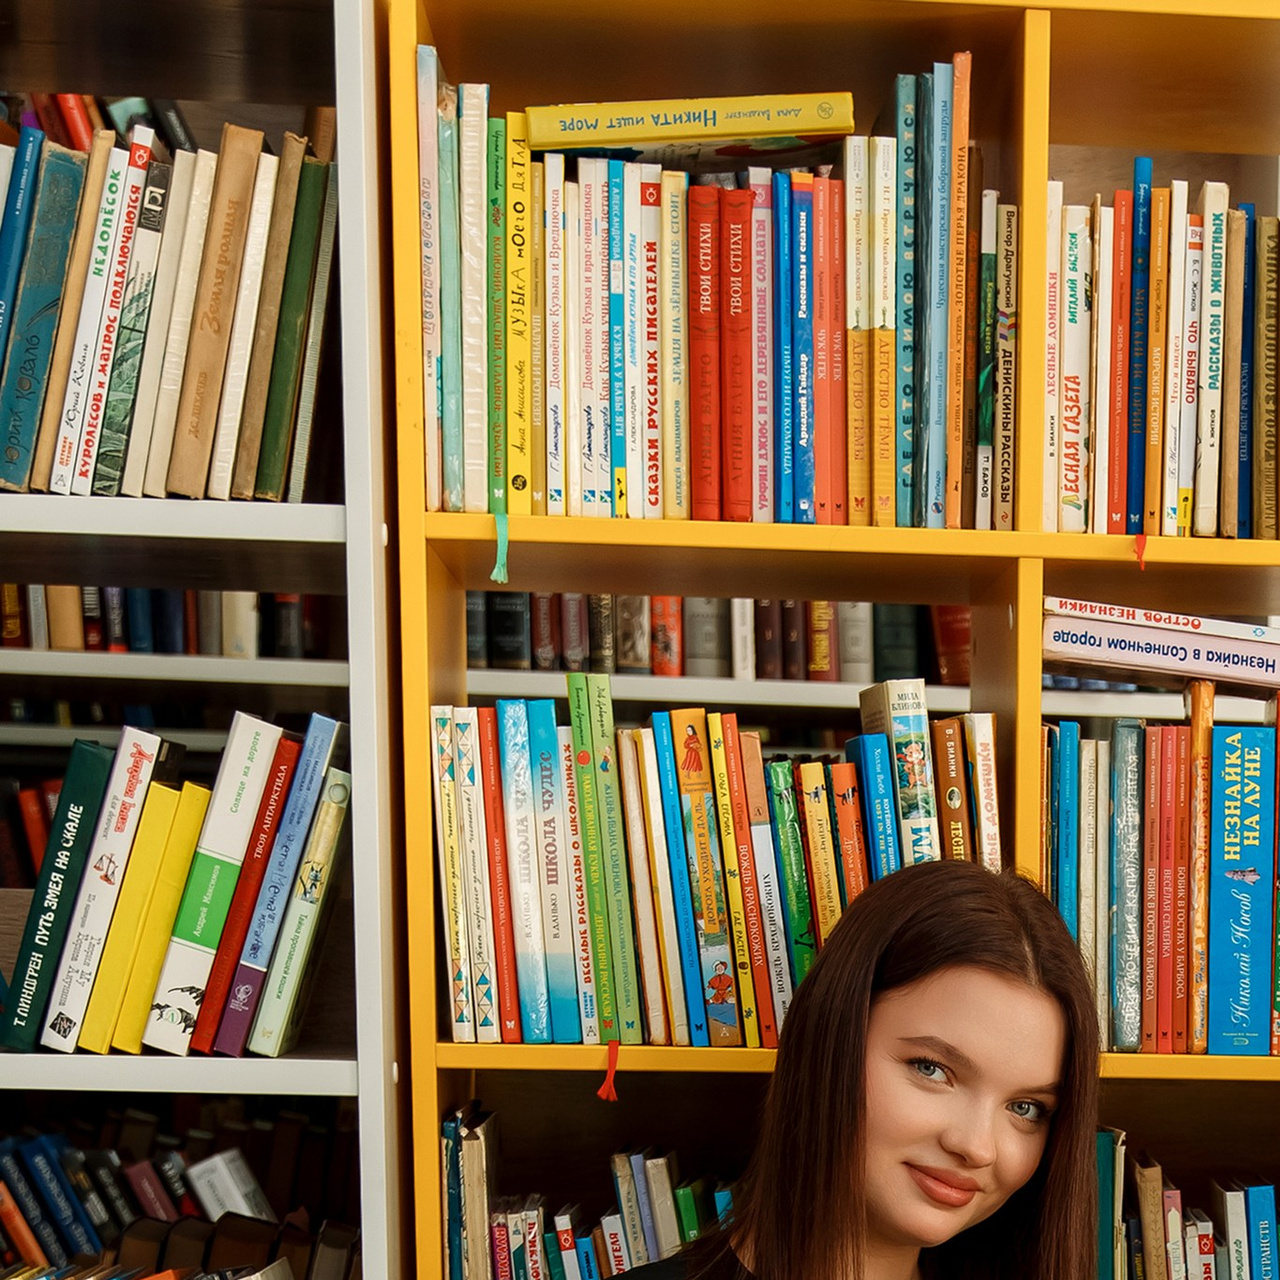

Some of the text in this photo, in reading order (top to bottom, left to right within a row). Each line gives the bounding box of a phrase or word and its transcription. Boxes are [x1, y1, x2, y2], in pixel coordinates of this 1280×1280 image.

[941, 100, 950, 143] запруды
[938, 147, 948, 193] бобровой
[93, 169, 121, 277] НЕДОПЁСОК
[698, 223, 712, 313] ТВОИ СТИХИ
[799, 212, 808, 251] сказки
[938, 205, 949, 261] мастерская
[955, 145, 966, 306] ЗОЛОТЫЕ ПЕРЬЯ ДРАКОНА
[549, 189, 561, 389] Домовёнок Кузька и Вреднючка
[668, 191, 682, 385] ЗЕМЛЯ НА ЗЁРНЫШКЕ СТОИТ
[798, 265, 808, 319] Рассказы
[936, 264, 947, 309] Чудесная
[1208, 212, 1223, 390] РАССКАЗЫ О ЖИВОТНЫХ
[1047, 272, 1057, 397] ЛЕСНЫЕ ДОМИШКИ
[1000, 348, 1011, 503] ДЕНИСКИНЫ РАССКАЗЫ
[1061, 375, 1082, 509] ЛЕСНАЯ ГАЗЕТА
[1052, 628, 1103, 649] городе
[1107, 637, 1189, 663] Солнечном
[1193, 649, 1202, 659] в
[1205, 648, 1277, 674] Незнайка
[59, 804, 83, 847] СКАЛЕ
[252, 765, 287, 859] ТВОЯ АНТАРКТИДА
[540, 751, 558, 885] ШКОЛА ЧУДЕС
[1222, 733, 1242, 860] НЕЗНАЙКА
[1244, 747, 1261, 846] НА ЛУНЕ
[43, 873, 64, 909] ЗМЕЯ
[54, 850, 71, 869] НА
[563, 743, 592, 983] ВЕСЁЛЫЕ РАССКАЗЫ О ШКОЛЬНИКАХ
[34, 911, 55, 946] ПУТЬ
[762, 873, 786, 993] ВОЖДЬ КРАСНОКОЖИХ
[1228, 888, 1253, 1027] Николай Носов
[15, 952, 44, 1018] ЛИНДГРЕН
